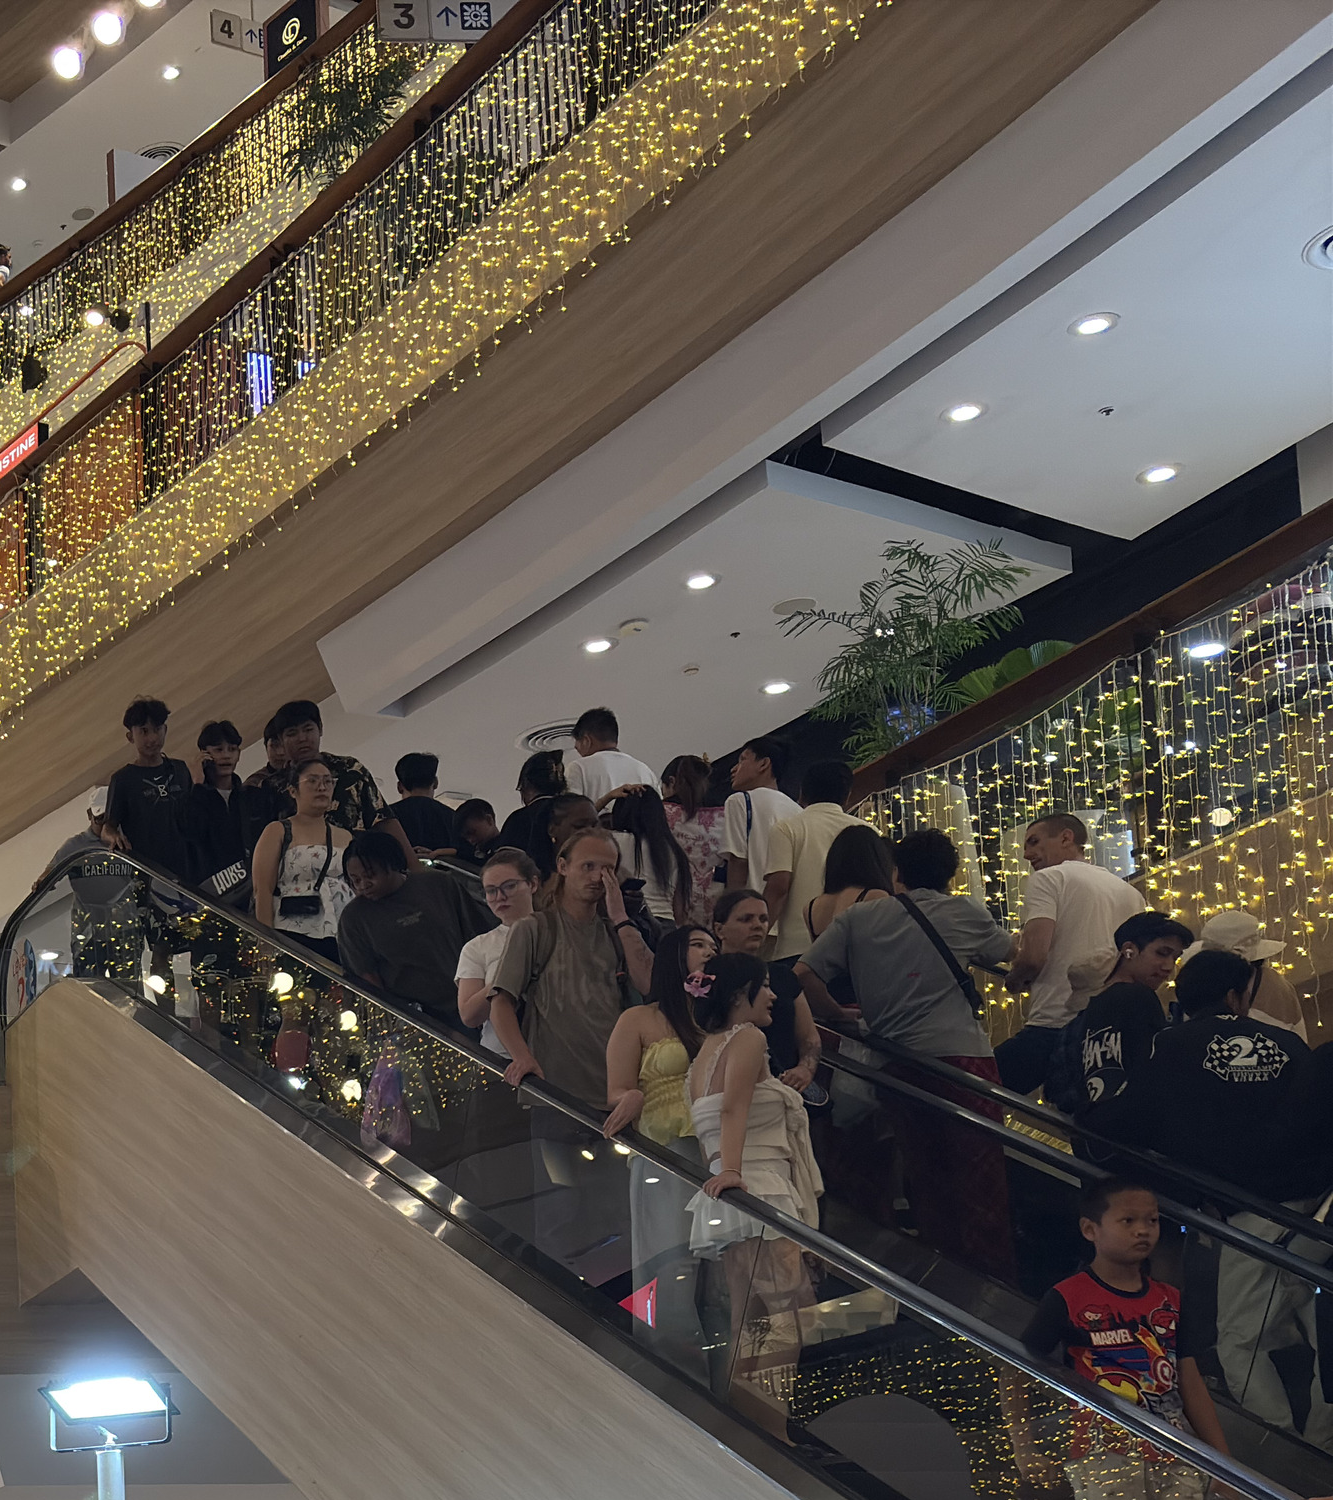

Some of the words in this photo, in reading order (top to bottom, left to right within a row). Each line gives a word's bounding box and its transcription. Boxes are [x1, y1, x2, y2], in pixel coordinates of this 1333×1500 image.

[393, 2, 415, 29] 3
[219, 19, 234, 39] 4
[1229, 1037, 1259, 1066] 2
[1090, 1328, 1134, 1347] MARVEL
